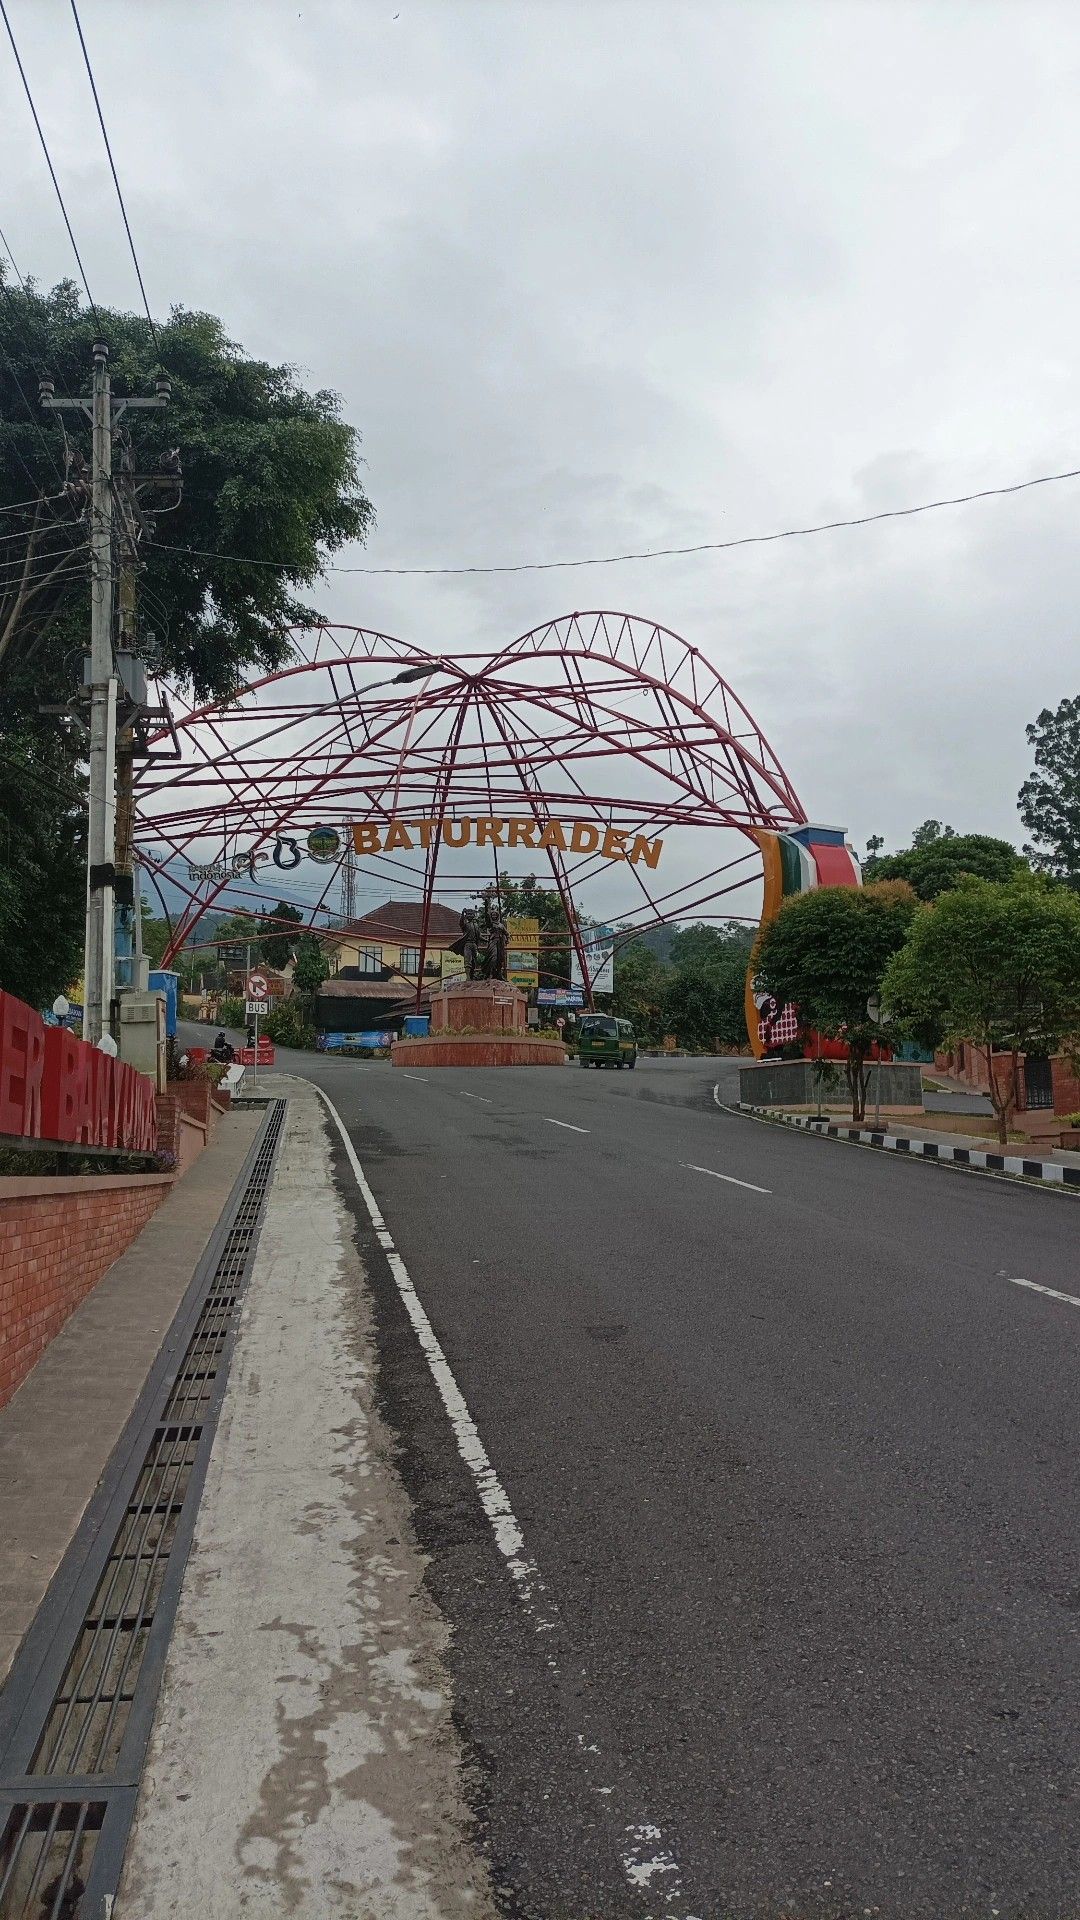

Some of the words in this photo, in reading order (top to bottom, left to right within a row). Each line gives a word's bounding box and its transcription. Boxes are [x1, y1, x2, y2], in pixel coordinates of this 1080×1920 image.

[352, 816, 664, 869] BATURRADEN
[189, 870, 242, 881] indonesia
[248, 1002, 267, 1013] BUS
